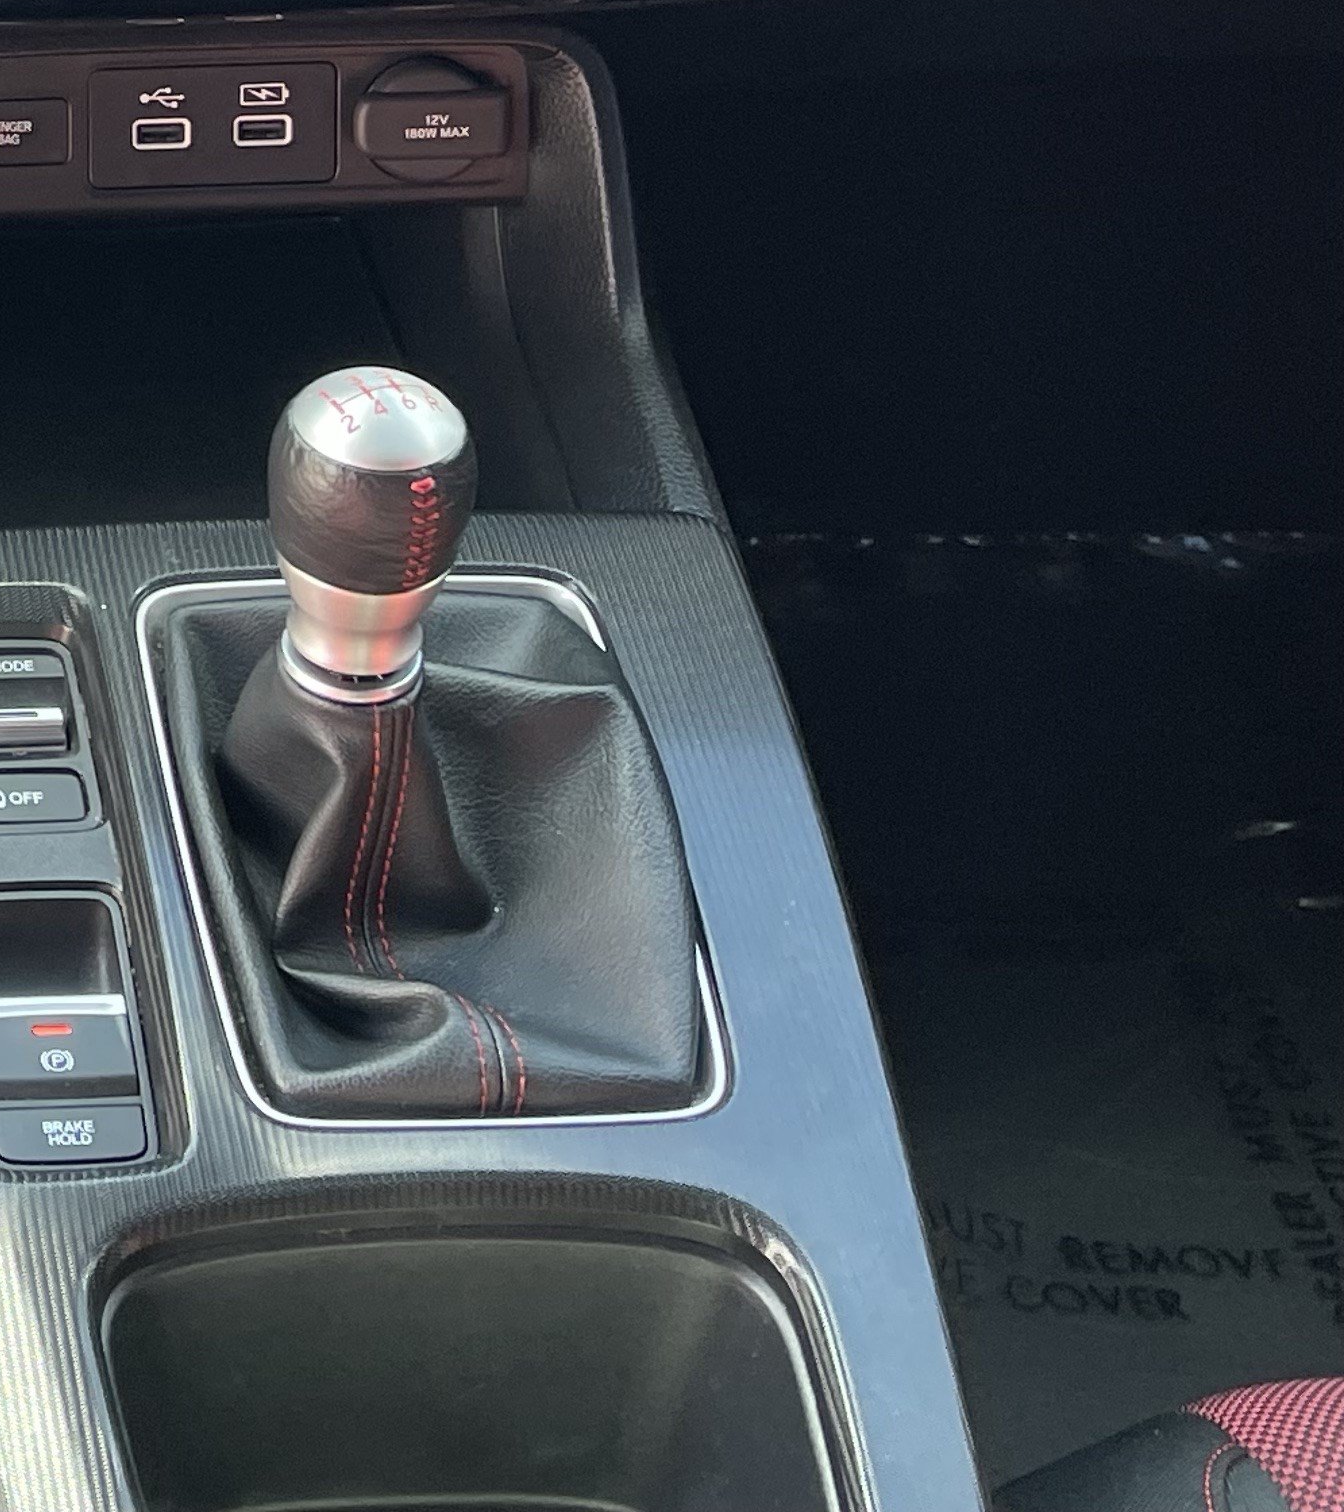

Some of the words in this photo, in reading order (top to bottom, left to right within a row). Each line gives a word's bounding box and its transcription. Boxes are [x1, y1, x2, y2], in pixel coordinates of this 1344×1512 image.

[425, 114, 450, 126] 12V
[404, 127, 437, 139] 180W
[439, 126, 470, 138] MAX
[340, 414, 361, 434] 2
[9, 791, 44, 805] OFF
[41, 1120, 95, 1134] BRAKE
[48, 1133, 93, 1146] HOLD
